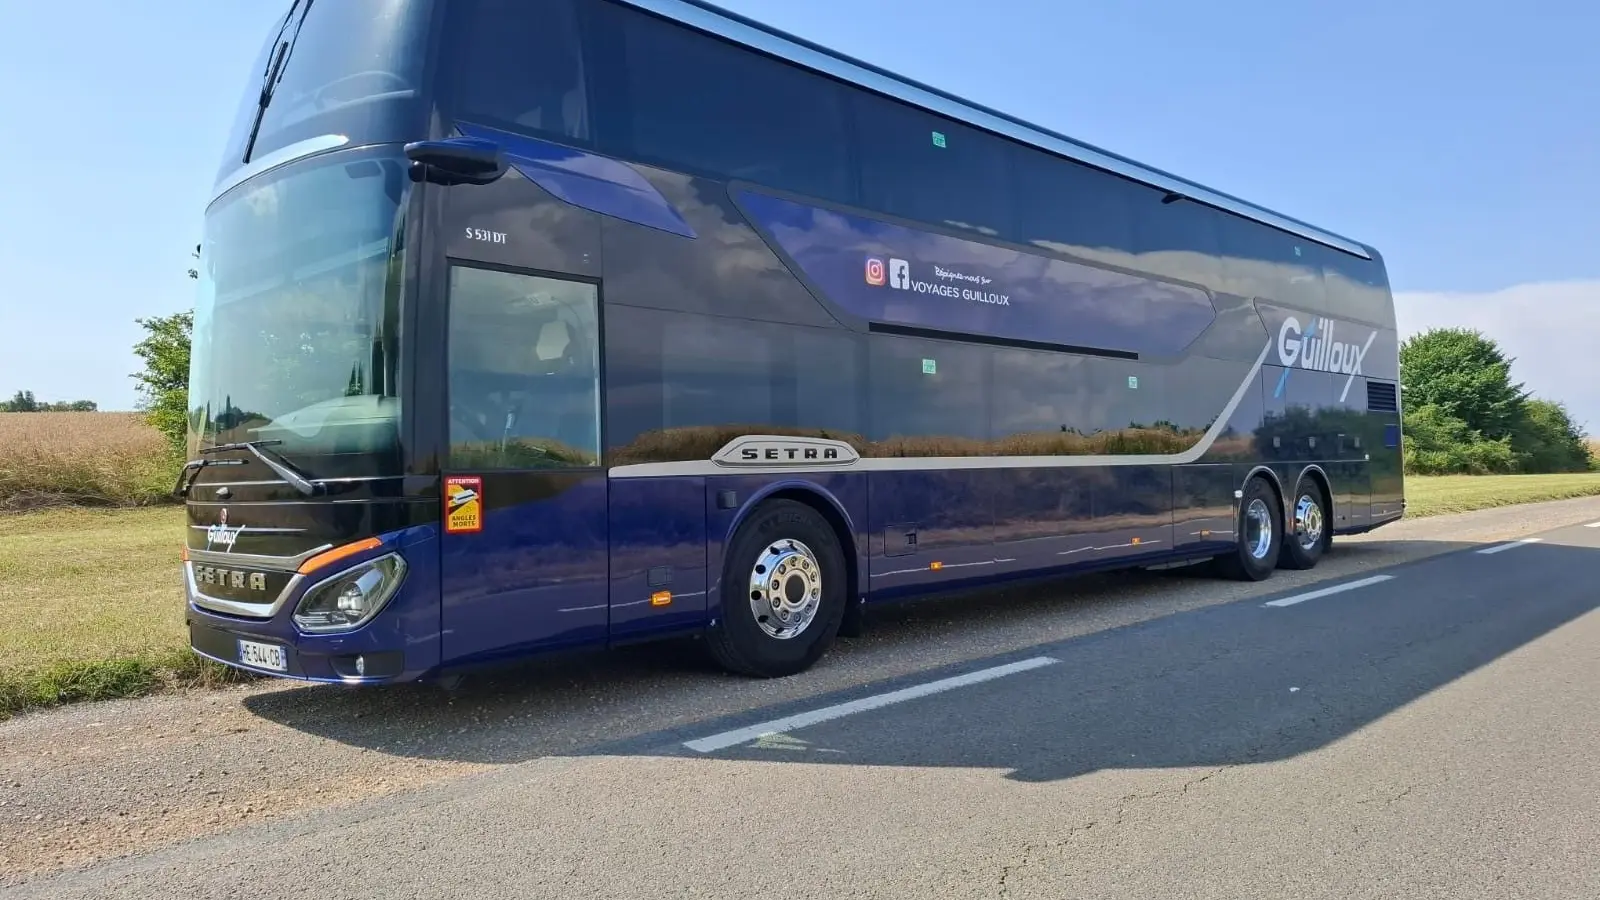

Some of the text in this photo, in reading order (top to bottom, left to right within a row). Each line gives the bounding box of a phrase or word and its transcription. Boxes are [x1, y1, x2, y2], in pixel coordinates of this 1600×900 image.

[466, 227, 508, 244] S 531 DT
[911, 280, 1010, 306] VOYAGES GUILLOUX
[1277, 316, 1377, 402] Guilloux
[741, 448, 838, 460] SETRA
[207, 524, 246, 553] Guilloux
[196, 565, 267, 591] SETRA
